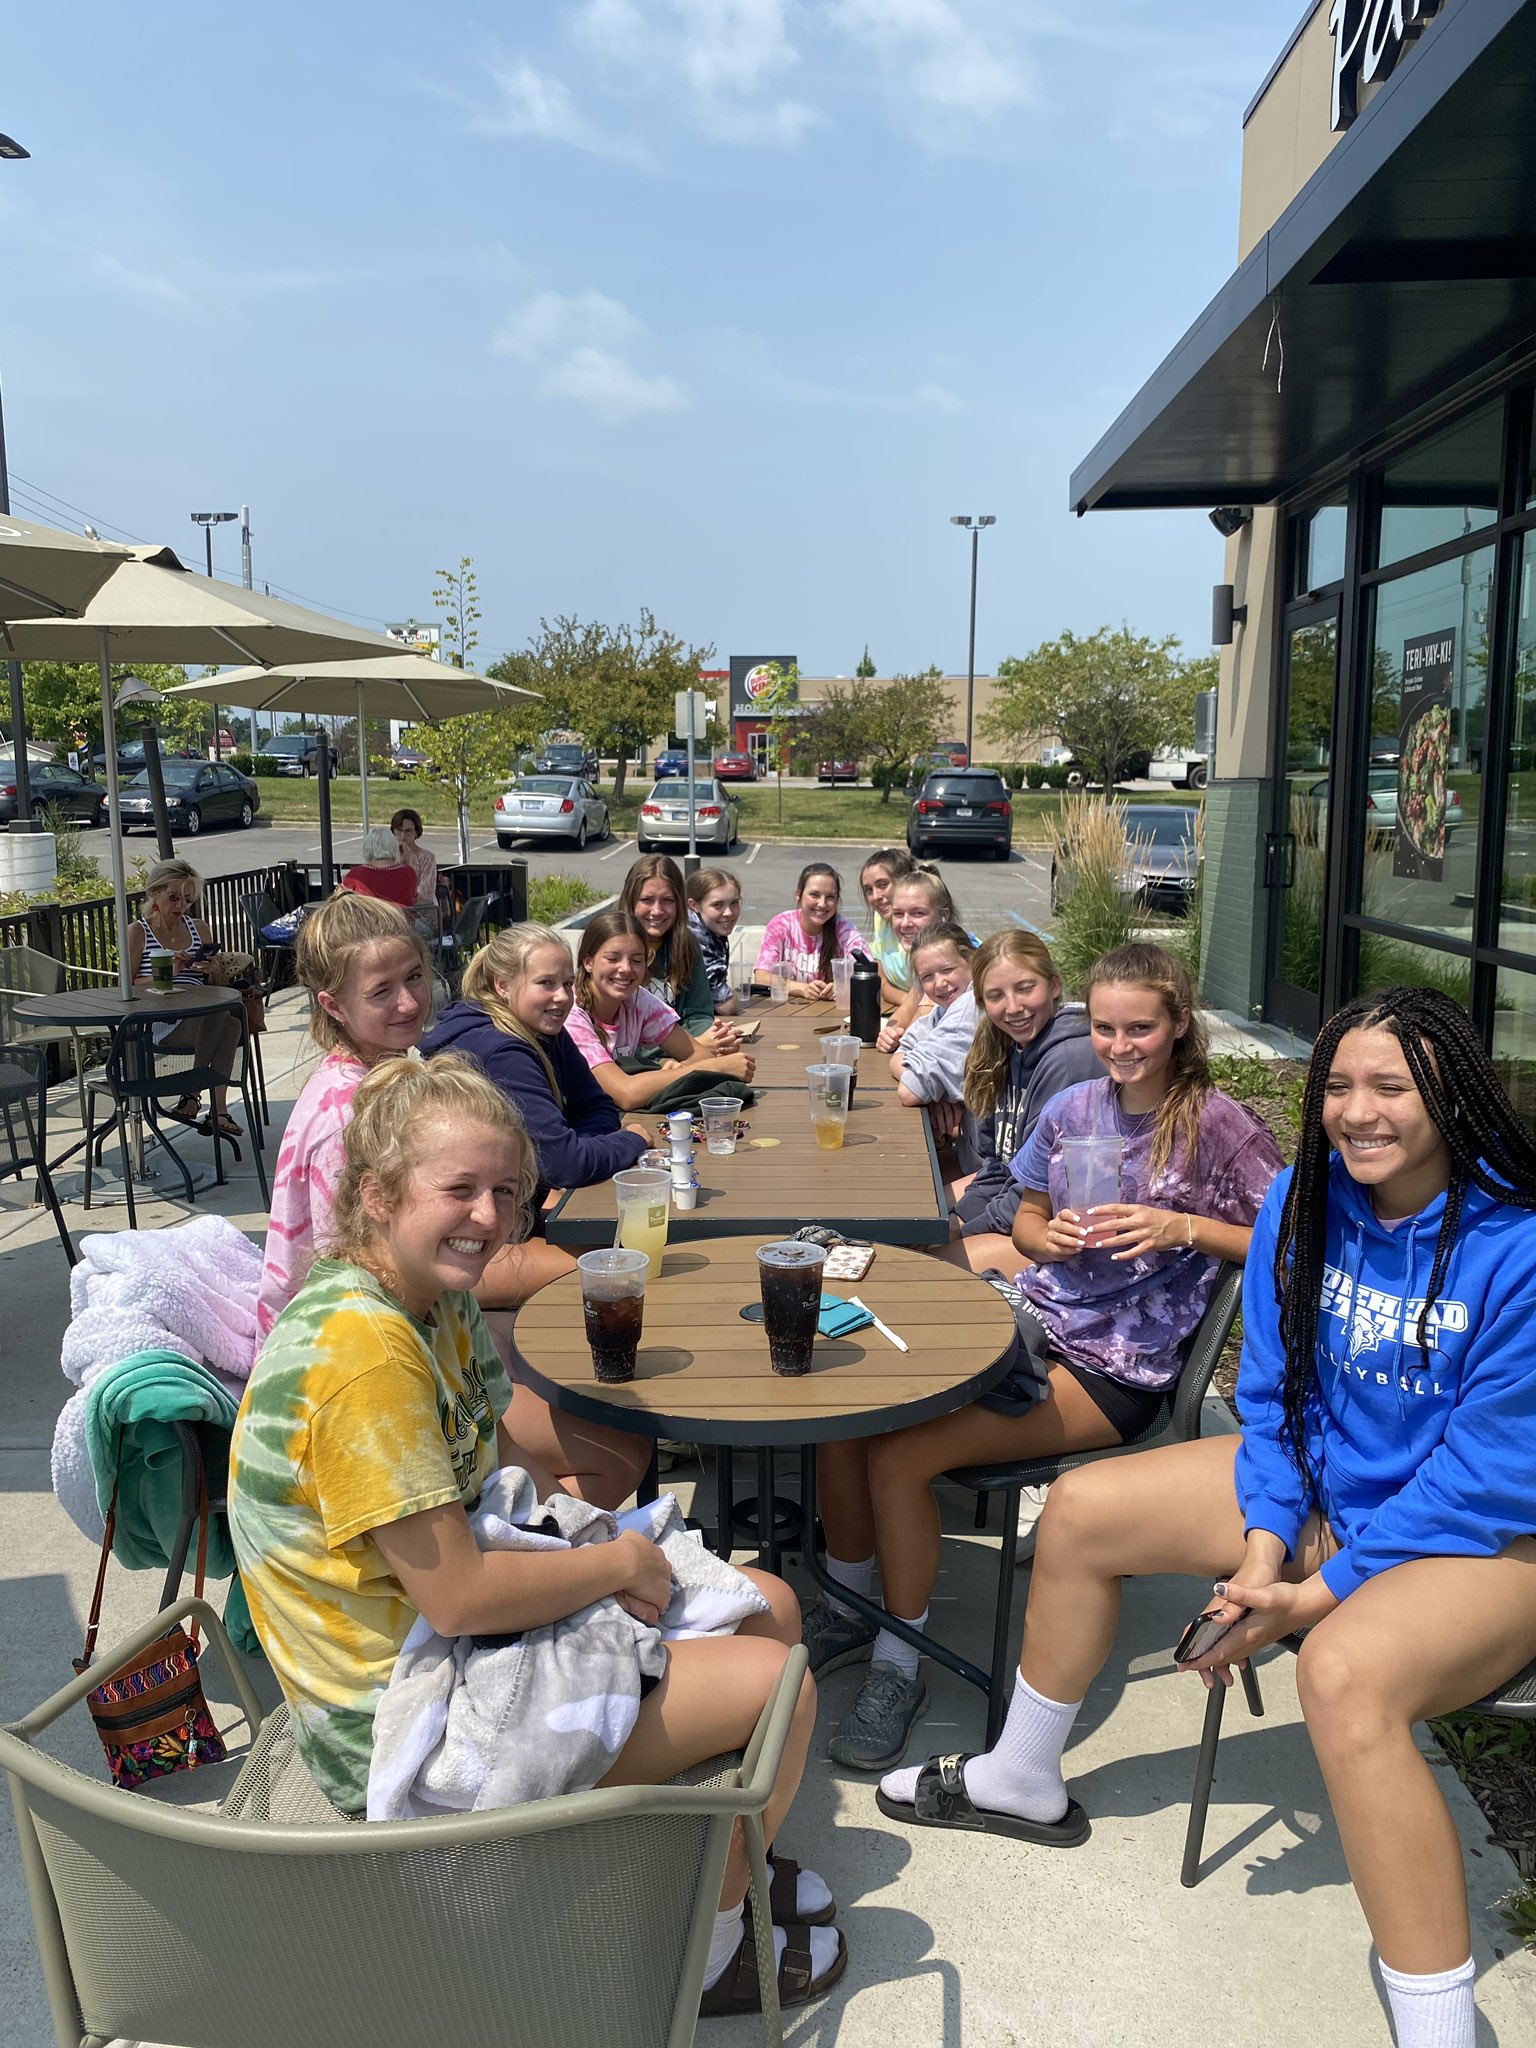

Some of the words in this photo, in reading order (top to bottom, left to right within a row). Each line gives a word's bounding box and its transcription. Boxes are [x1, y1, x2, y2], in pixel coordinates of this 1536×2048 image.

[1406, 640, 1452, 671] TERI-YAY-KI!
[751, 682, 769, 694] KIN
[784, 948, 821, 973] FIGH
[1322, 1266, 1465, 1332] OREHEAD
[1315, 1342, 1443, 1395] LLEYBALL
